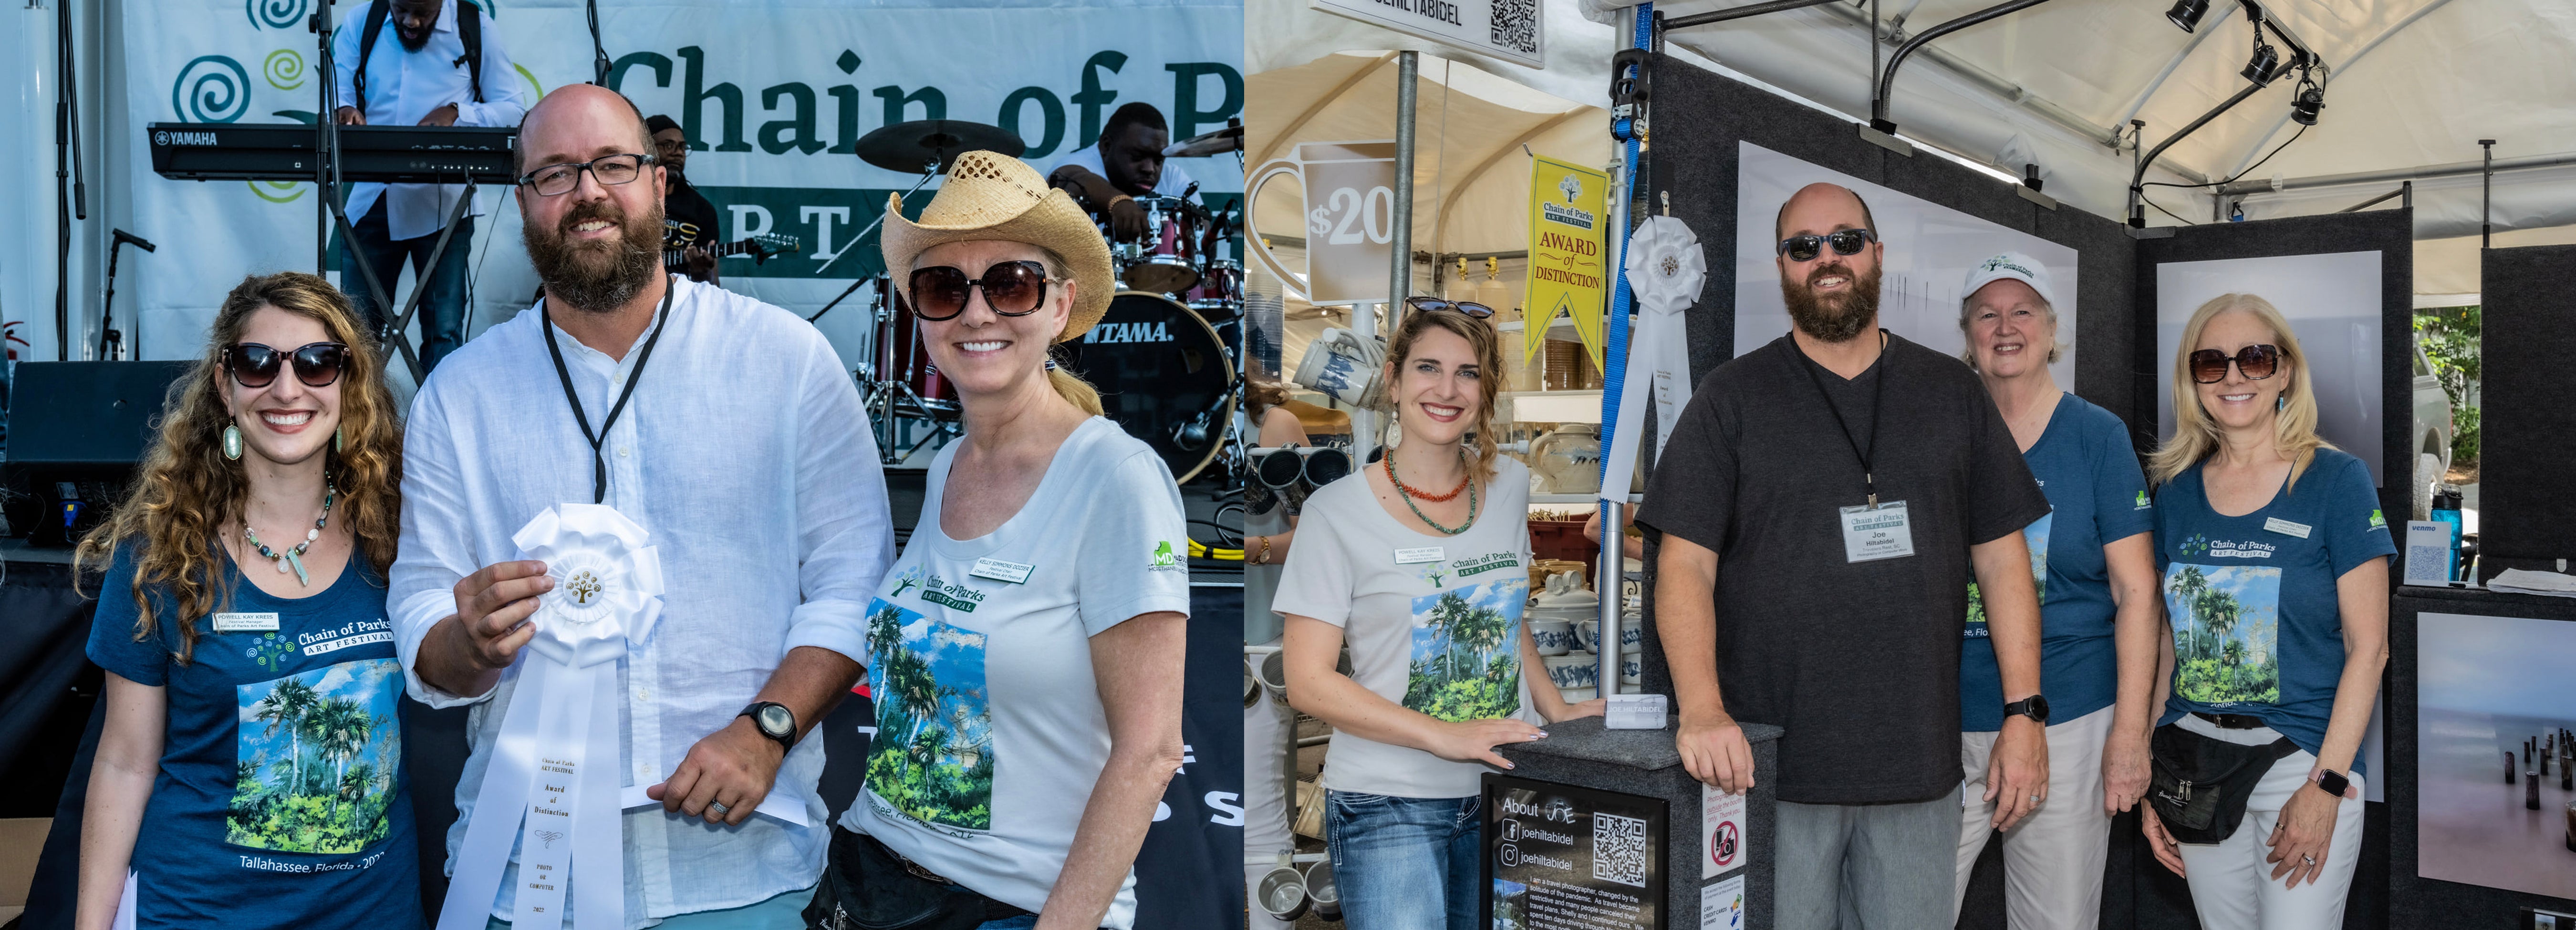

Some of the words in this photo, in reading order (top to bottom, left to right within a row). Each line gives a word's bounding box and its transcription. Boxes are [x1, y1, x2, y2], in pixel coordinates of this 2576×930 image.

[998, 50, 1129, 159] of
[170, 132, 217, 145] YAMAHA
[1310, 186, 1394, 245] $20
[1543, 202, 1565, 214] Chain
[1567, 207, 1574, 216] of
[1575, 209, 1593, 221] Parks
[1562, 217, 1590, 228] FESTIVAL
[1539, 231, 1596, 257] AWARD
[1564, 254, 1577, 270] of
[1535, 266, 1600, 289] DISTINCTION
[1100, 321, 1168, 343] TAMA
[1851, 517, 1872, 525] Chain
[2211, 540, 2236, 548] Chain
[2238, 540, 2248, 550] of
[2249, 541, 2276, 551] Parks
[1155, 552, 1174, 565] MD
[1453, 558, 1479, 568] Chain
[1481, 554, 1490, 563] of
[1492, 551, 1517, 560] Parks
[1460, 568, 1475, 576] ART
[1479, 561, 1517, 572] FESTIVAL
[927, 574, 944, 589] Chain
[944, 584, 959, 595] of
[956, 586, 986, 602] Parks
[923, 591, 936, 601] ART
[936, 593, 971, 611] FESTIVAL
[299, 629, 338, 645] Chain
[340, 622, 354, 635] of
[356, 618, 391, 632] Parks
[308, 643, 329, 653] ART
[336, 633, 392, 647] FESTIVAL
[545, 784, 565, 793] Award
[534, 806, 569, 817] Distinction
[1503, 797, 1539, 817] About
[1547, 807, 1576, 825] JOE
[1521, 827, 1573, 846] joehiltabidel
[240, 855, 312, 874] Tallahassee,
[314, 862, 354, 872] Florida
[1520, 851, 1572, 871] joehiltabidel
[530, 883, 554, 891] COMPUTER
[1547, 879, 1561, 888] travel
[1562, 882, 1597, 895] photographer,
[1598, 890, 1620, 899] changed
[1622, 894, 1629, 902] by
[1630, 895, 1639, 903] the
[1530, 885, 1549, 894] solitude
[1566, 893, 1592, 903] pandemic.
[1603, 899, 1618, 908] travel
[1619, 902, 1640, 913] became
[1530, 894, 1554, 904] restrictive
[1566, 901, 1580, 910] many
[1581, 905, 1599, 913] people
[1600, 909, 1623, 918] canceled
[1624, 912, 1636, 921] their
[1529, 902, 1544, 910] travel
[1545, 906, 1559, 915] plans,
[1561, 908, 1577, 919] Shelly
[1592, 916, 1617, 926] continued
[1529, 911, 1544, 920] spent
[1553, 916, 1566, 925] days
[1567, 919, 1584, 929] driving
[1703, 910, 1715, 919] CREDIT
[1716, 907, 1727, 915] CARDS
[1703, 918, 1716, 926] VENMO
